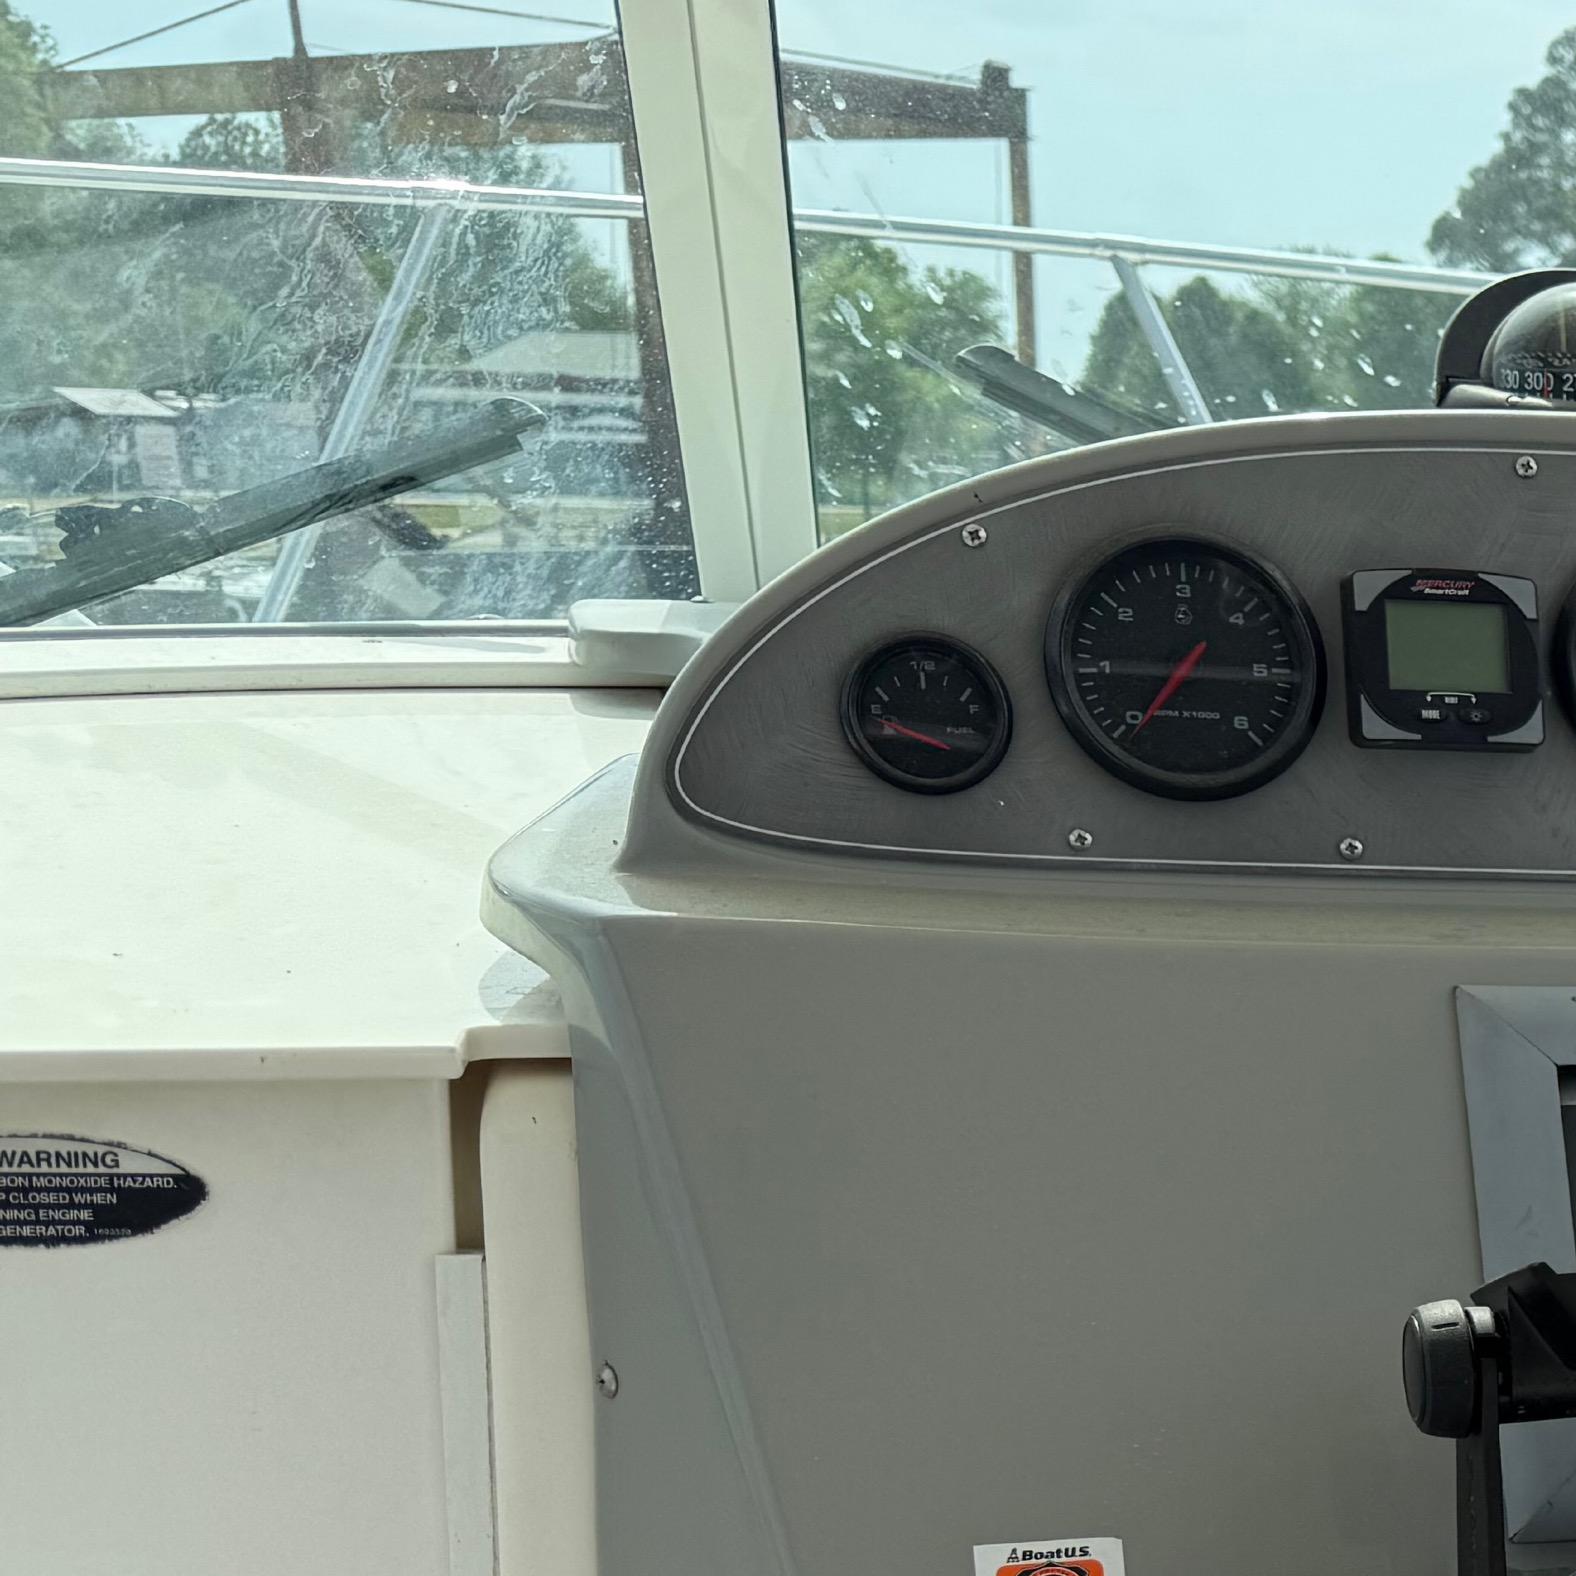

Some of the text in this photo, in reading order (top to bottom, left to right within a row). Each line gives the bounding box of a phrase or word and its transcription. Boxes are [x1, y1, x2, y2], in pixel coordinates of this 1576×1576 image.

[1415, 580, 1475, 588] MERCURY
[1176, 584, 1191, 597] 3
[1118, 608, 1134, 621] 2
[1229, 613, 1244, 625] 4
[910, 661, 936, 671] 1/2
[1253, 664, 1268, 677] 5
[870, 704, 882, 715] E
[969, 704, 980, 714] F
[1234, 716, 1249, 729] 6
[0, 1150, 120, 1169] WARNING
[33, 1177, 177, 1188] MONOXIDE HAZARD.
[9, 1193, 117, 1204] CLOSED WHEN
[39, 1209, 94, 1220] ENGINE
[0, 1225, 90, 1237] GENERATOR.
